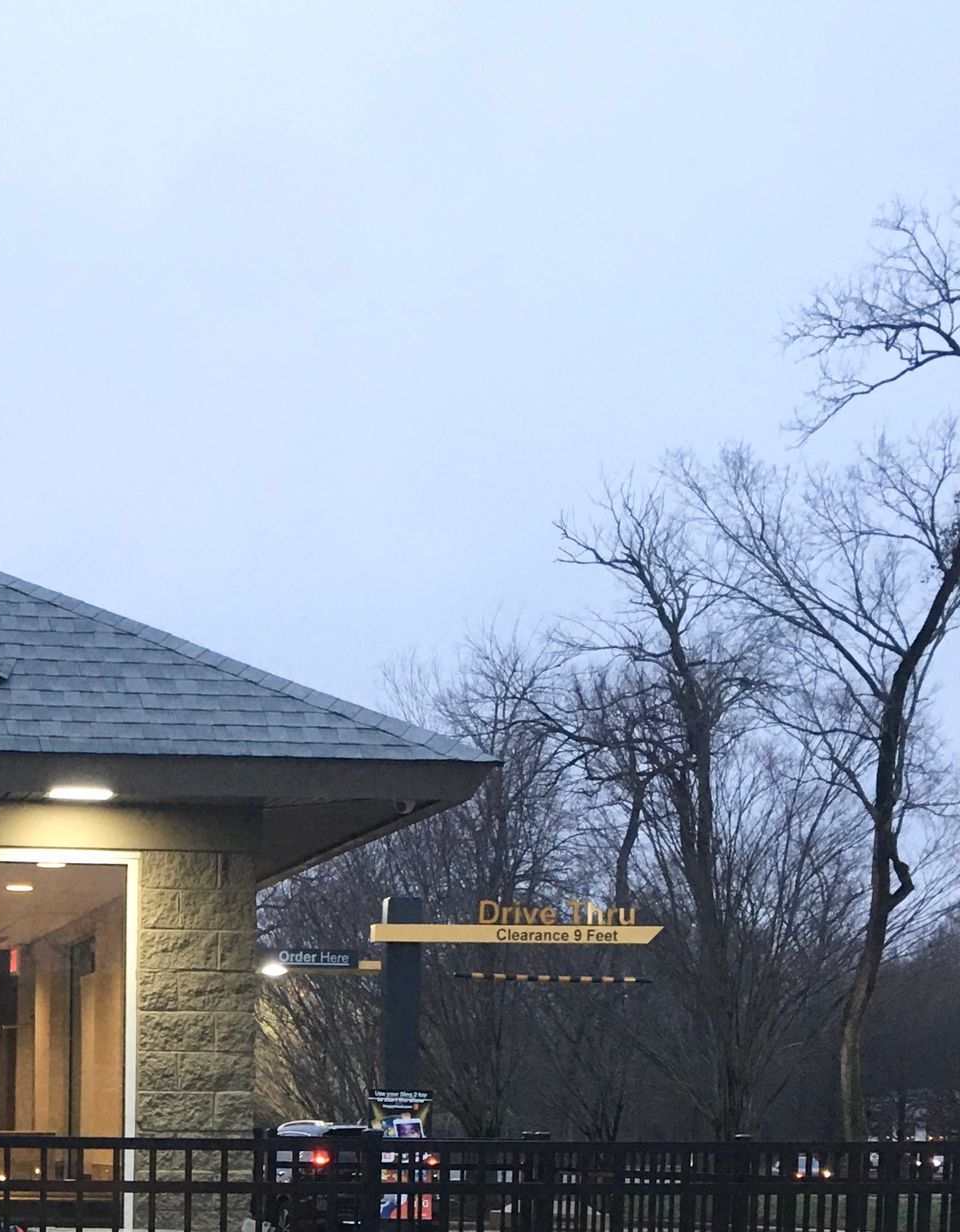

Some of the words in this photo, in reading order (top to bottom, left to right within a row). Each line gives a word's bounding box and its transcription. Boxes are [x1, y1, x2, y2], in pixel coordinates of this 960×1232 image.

[479, 900, 557, 924] Drive
[566, 902, 636, 925] Thru
[496, 928, 569, 941] Clearance
[574, 929, 582, 941] 9
[587, 930, 618, 942] Feet
[279, 950, 317, 962] Order
[320, 951, 349, 963] Here
